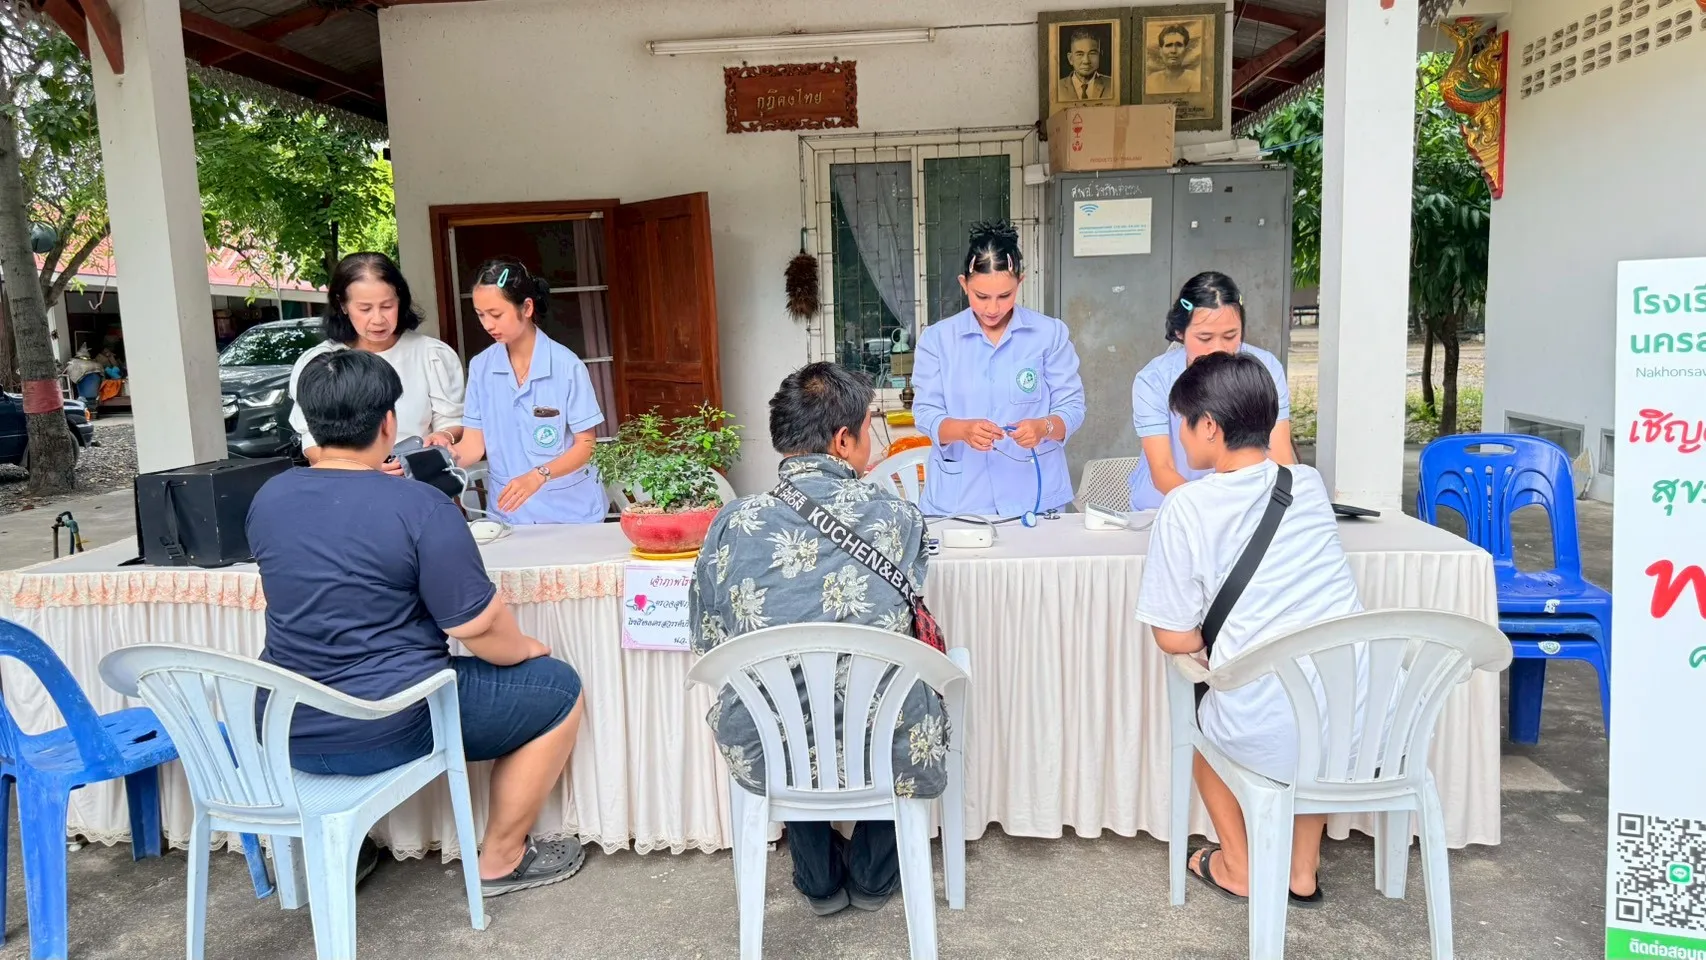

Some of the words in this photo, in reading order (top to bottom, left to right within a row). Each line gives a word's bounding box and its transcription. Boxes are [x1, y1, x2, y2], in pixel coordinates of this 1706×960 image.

[1629, 408, 1706, 454] เชิญ
[1651, 478, 1706, 517] สุข
[650, 575, 693, 588] เจ้าภาพโร
